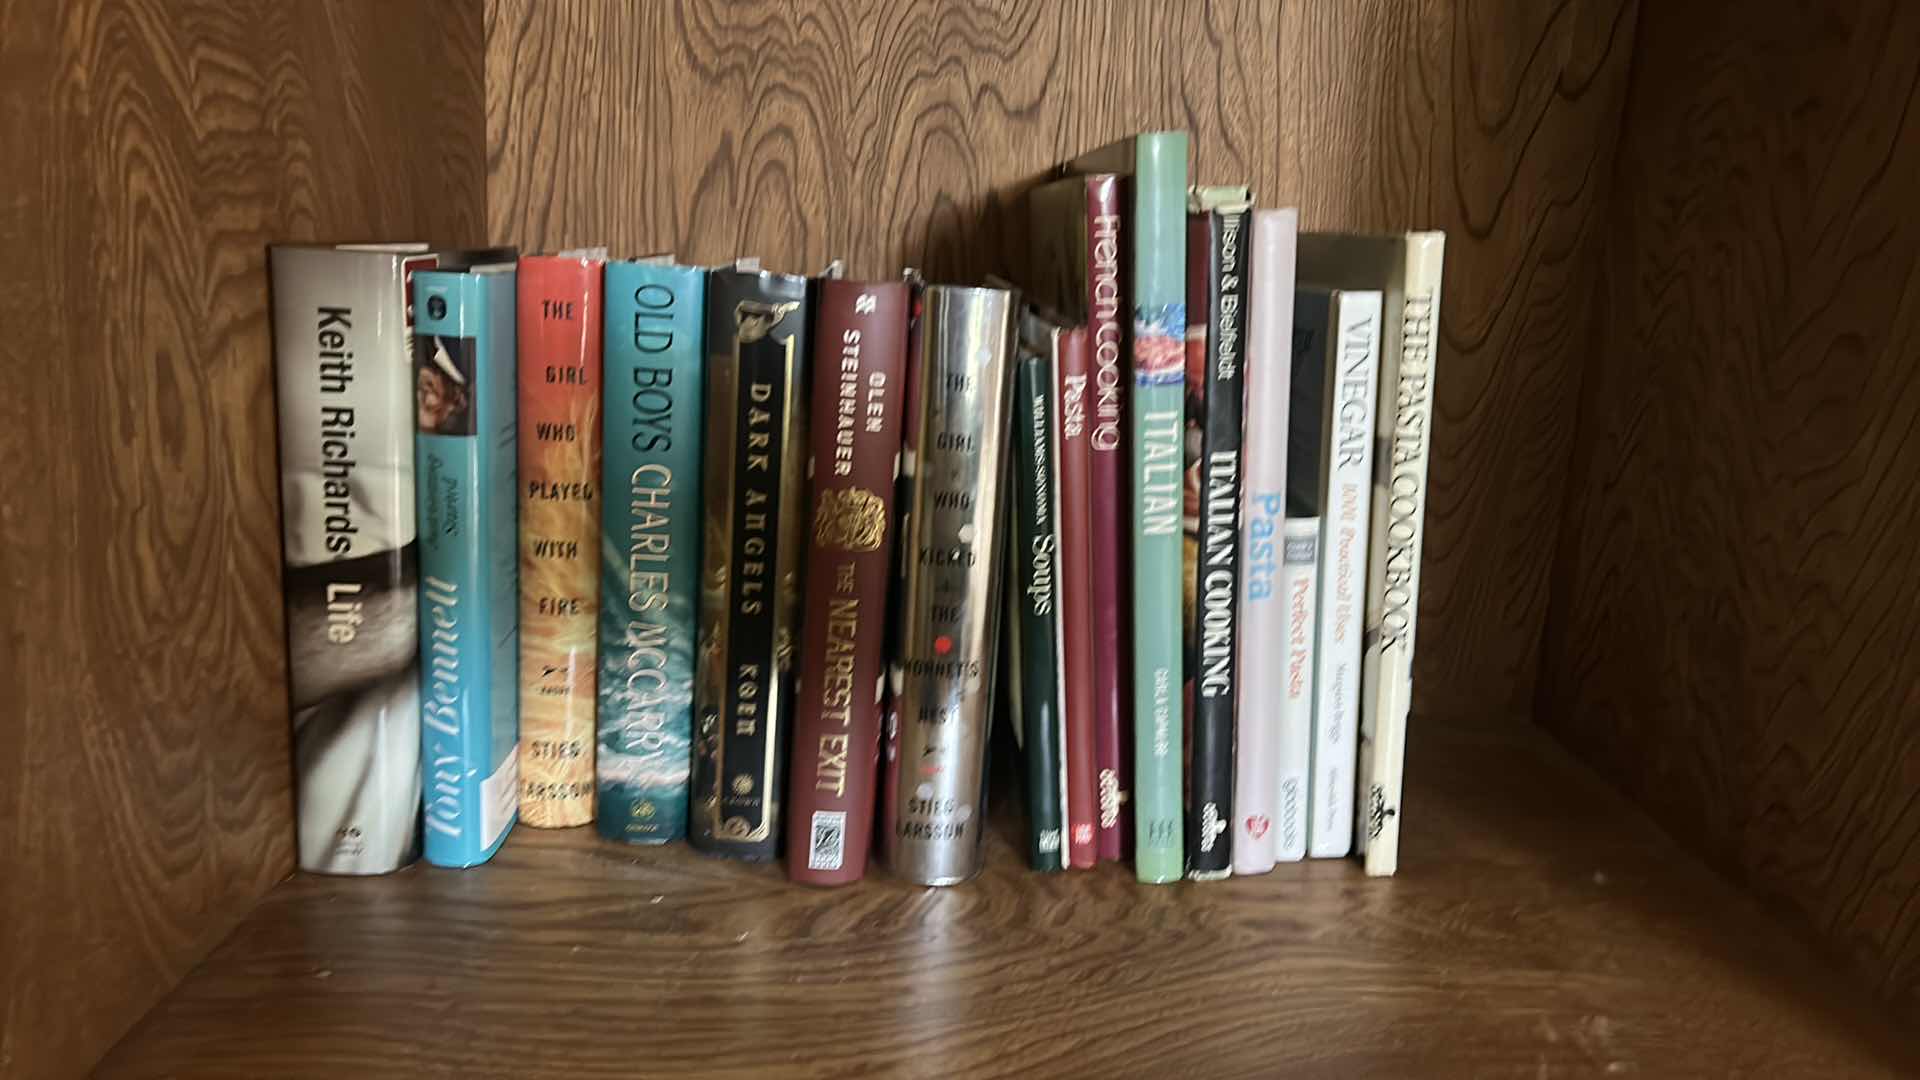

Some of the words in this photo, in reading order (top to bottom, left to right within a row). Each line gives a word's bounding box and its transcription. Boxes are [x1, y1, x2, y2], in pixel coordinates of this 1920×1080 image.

[1094, 215, 1120, 319] French
[1222, 214, 1240, 272] llison
[541, 300, 575, 321] THE
[633, 283, 675, 354] OLD
[1220, 274, 1239, 292] &
[317, 306, 354, 394] Keith
[1401, 296, 1431, 367] THE
[544, 364, 588, 386] GIRL
[631, 367, 673, 454] BOYS
[833, 329, 861, 476] STEINHAUER
[865, 371, 887, 433] OLEN
[946, 375, 976, 393] THE
[1064, 374, 1088, 439] Pasta
[1091, 321, 1120, 450] Cooking
[1338, 315, 1373, 471] VINEGAR
[536, 422, 577, 442] WHO
[746, 383, 772, 472] DARK
[936, 433, 975, 451] GIRL
[1393, 371, 1426, 469] PASTA
[321, 406, 359, 557] Richards
[528, 480, 594, 501] PLAYED
[934, 492, 970, 509] WHO
[1144, 410, 1178, 535] ITALIAN
[629, 464, 673, 613] CHARLES
[1206, 450, 1239, 567] ITALIAN
[532, 540, 579, 560] WITH
[741, 491, 769, 616] ANGELS
[836, 560, 857, 593] THE
[1027, 533, 1054, 616] Soups
[1248, 490, 1281, 602] Pasta
[1380, 474, 1420, 653] COOKBOOK
[326, 582, 367, 645] Life
[538, 597, 580, 616] FIRE
[932, 606, 962, 623] THE
[1201, 569, 1233, 697] COOKING
[820, 599, 859, 727] NEAREST
[736, 663, 760, 736] KOEN
[530, 739, 581, 760] STIEG
[815, 734, 849, 798] EXIT
[424, 743, 479, 838] Tony
[907, 798, 954, 815] STIEG
[896, 821, 965, 841] LARSSON
